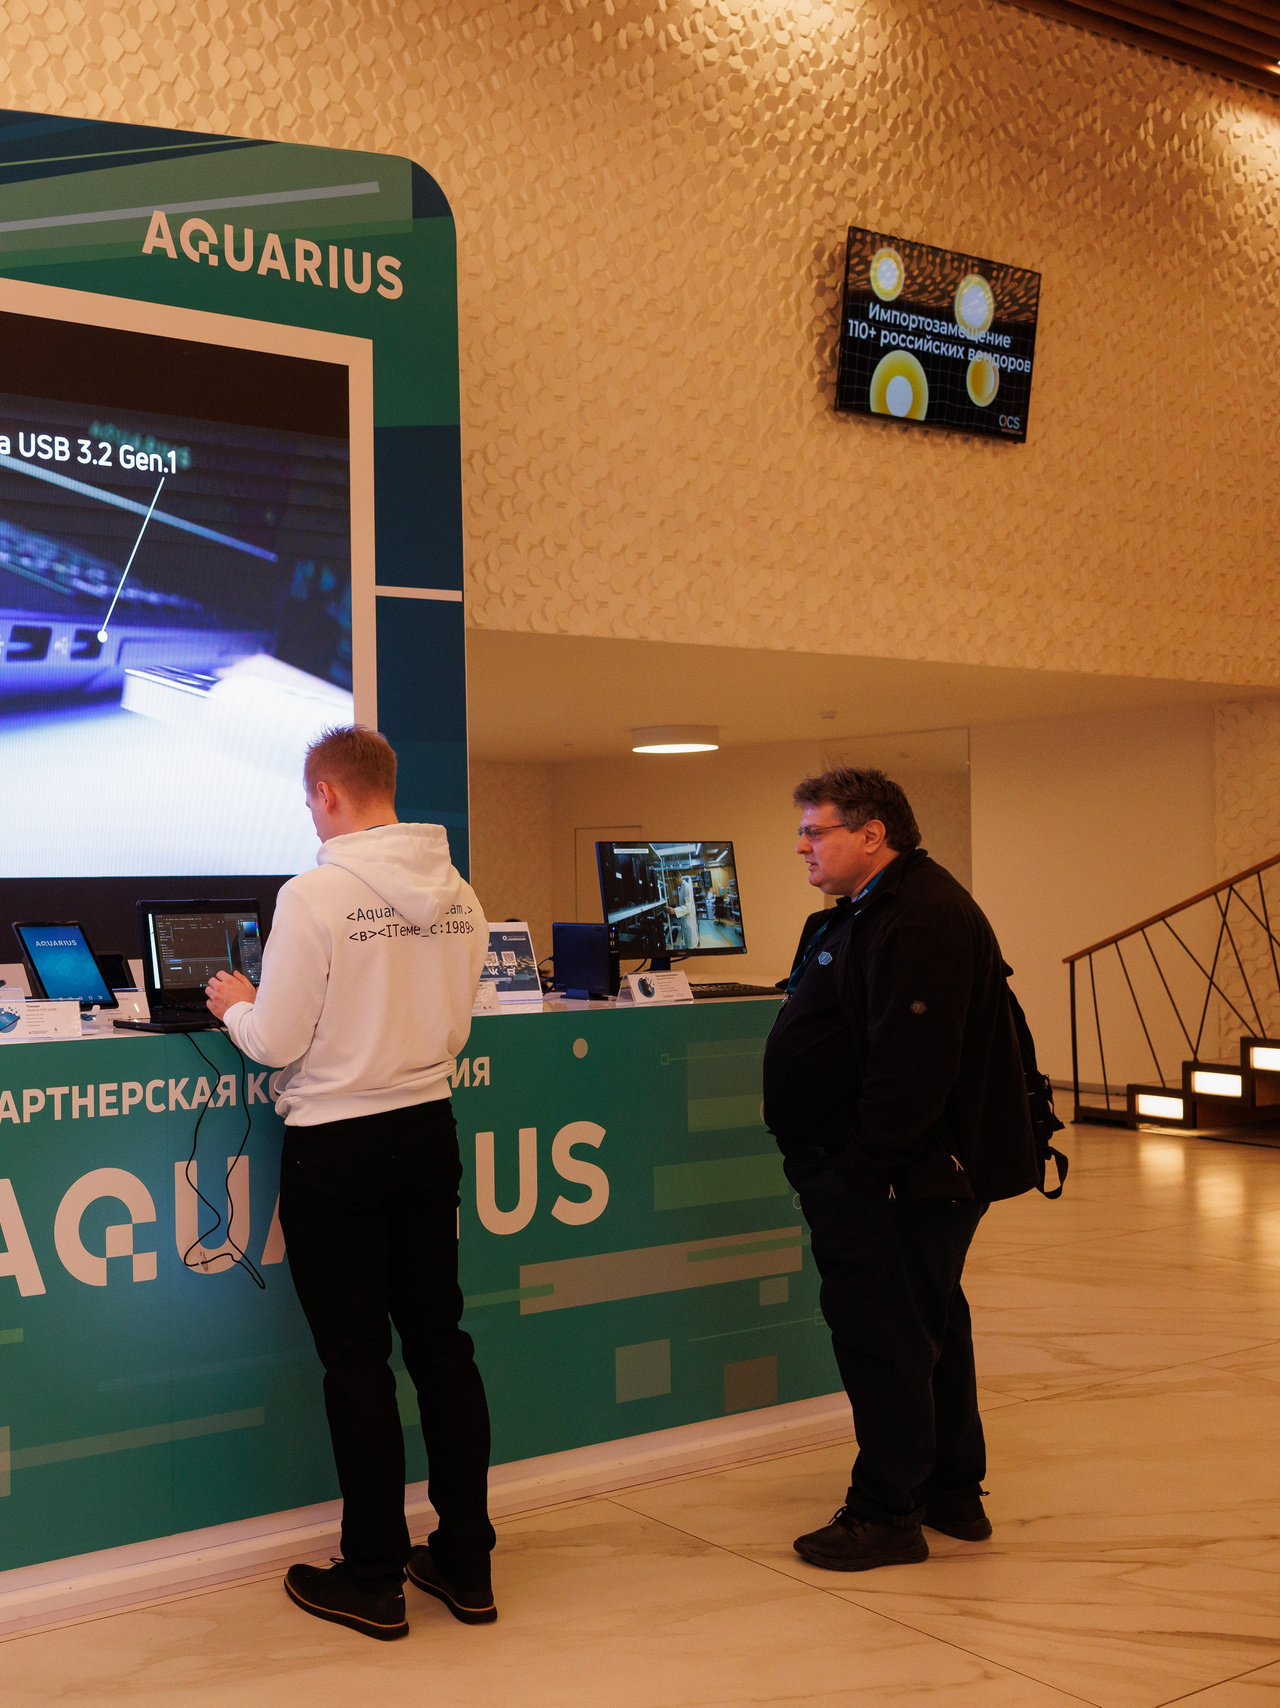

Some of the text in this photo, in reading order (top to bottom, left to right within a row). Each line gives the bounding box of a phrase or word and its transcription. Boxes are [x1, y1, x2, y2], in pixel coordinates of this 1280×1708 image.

[141, 209, 404, 300] AQUARIUS
[847, 319, 1032, 374] 110+ российских вендоров
[868, 301, 1012, 349] Импортозамещение
[998, 414, 1021, 430] OCS
[18, 432, 71, 462] USB
[76, 439, 113, 467] 3.2
[119, 444, 177, 475] Gen.1
